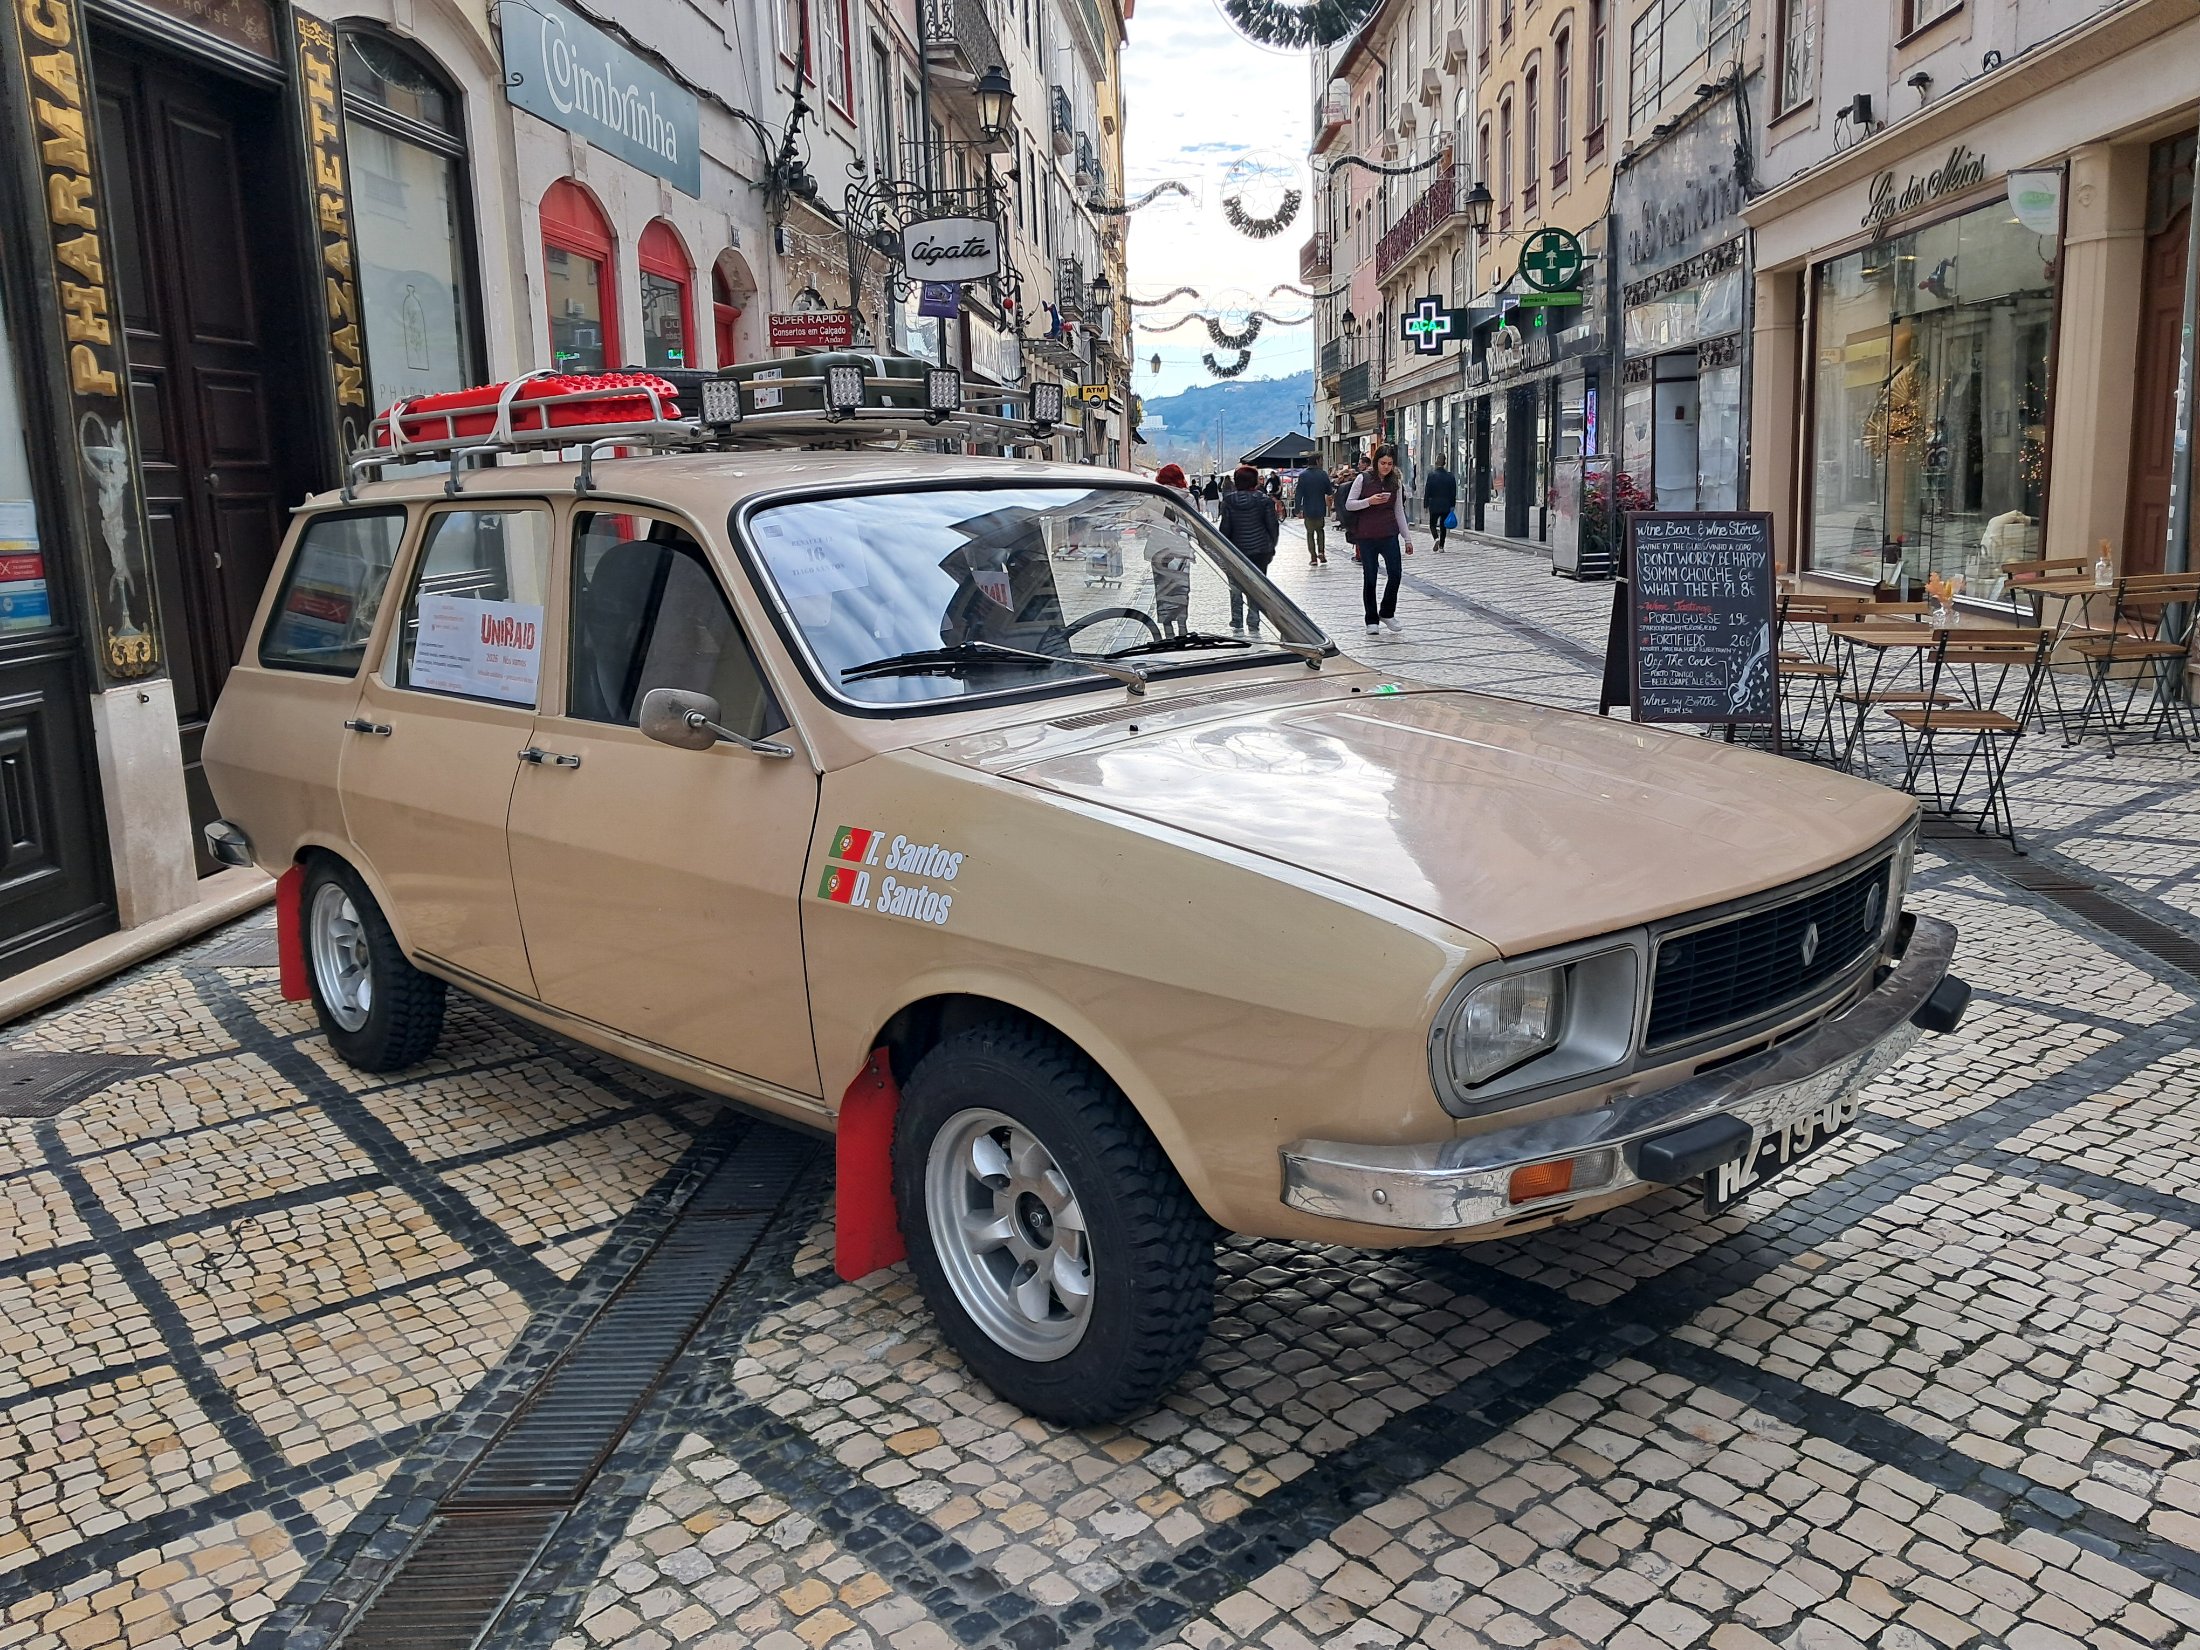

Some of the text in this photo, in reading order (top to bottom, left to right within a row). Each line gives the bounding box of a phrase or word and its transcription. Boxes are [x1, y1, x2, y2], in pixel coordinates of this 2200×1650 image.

[541, 12, 678, 165] Coimbrinha
[1861, 145, 1987, 242] Loja das Meias
[305, 51, 366, 408] NAZARETH
[771, 314, 846, 325] SUPER RAPIDO
[772, 328, 806, 337] Consertos
[819, 326, 847, 337] Calçado
[1086, 386, 1105, 394] ATM
[1665, 521, 1695, 536] Bar
[1728, 520, 1761, 536] Store
[806, 546, 826, 561] 16
[1643, 543, 1661, 551] WINE
[1662, 543, 1673, 552] BY
[1673, 543, 1685, 551] THE
[1675, 551, 1715, 567] WORRY
[1718, 552, 1731, 566] BE
[1732, 552, 1766, 568] HAPPY
[1642, 567, 1678, 582] SOMM
[1680, 567, 1733, 582] CHOICHE
[1643, 582, 1679, 597] WHAT
[1684, 582, 1709, 597] THE
[1648, 611, 1721, 625] PORTUGUESE
[1650, 633, 1706, 647] FORTIFIEDS
[1665, 653, 1686, 667] The
[1688, 654, 1718, 667] Cork
[1640, 692, 1719, 710] Wine by Bottle
[865, 830, 964, 881] T. Santos
[850, 870, 953, 925] D. Santos
